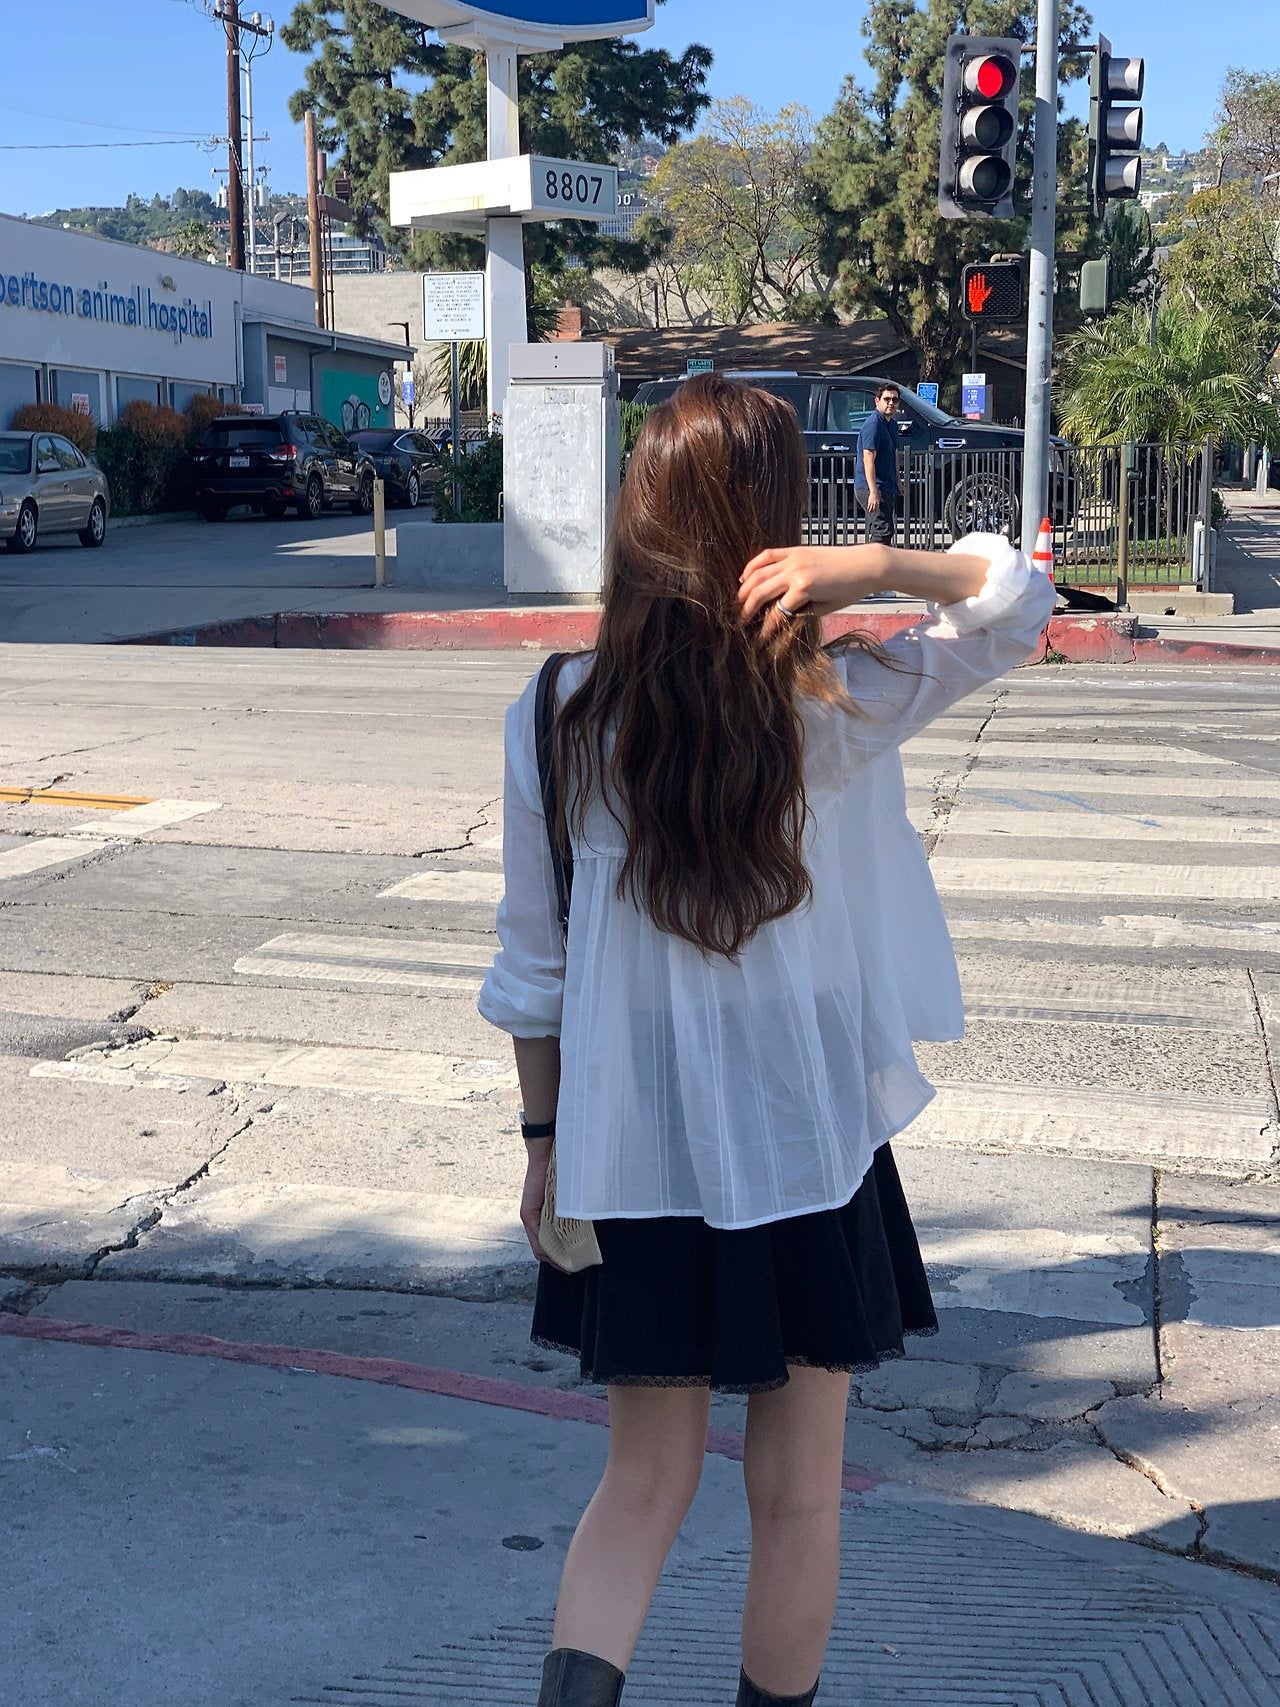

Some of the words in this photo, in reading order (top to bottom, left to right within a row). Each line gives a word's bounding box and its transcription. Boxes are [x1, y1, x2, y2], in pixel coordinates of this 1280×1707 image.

[546, 170, 603, 204] 8807
[81, 281, 141, 326] animal
[148, 288, 213, 344] hospital
